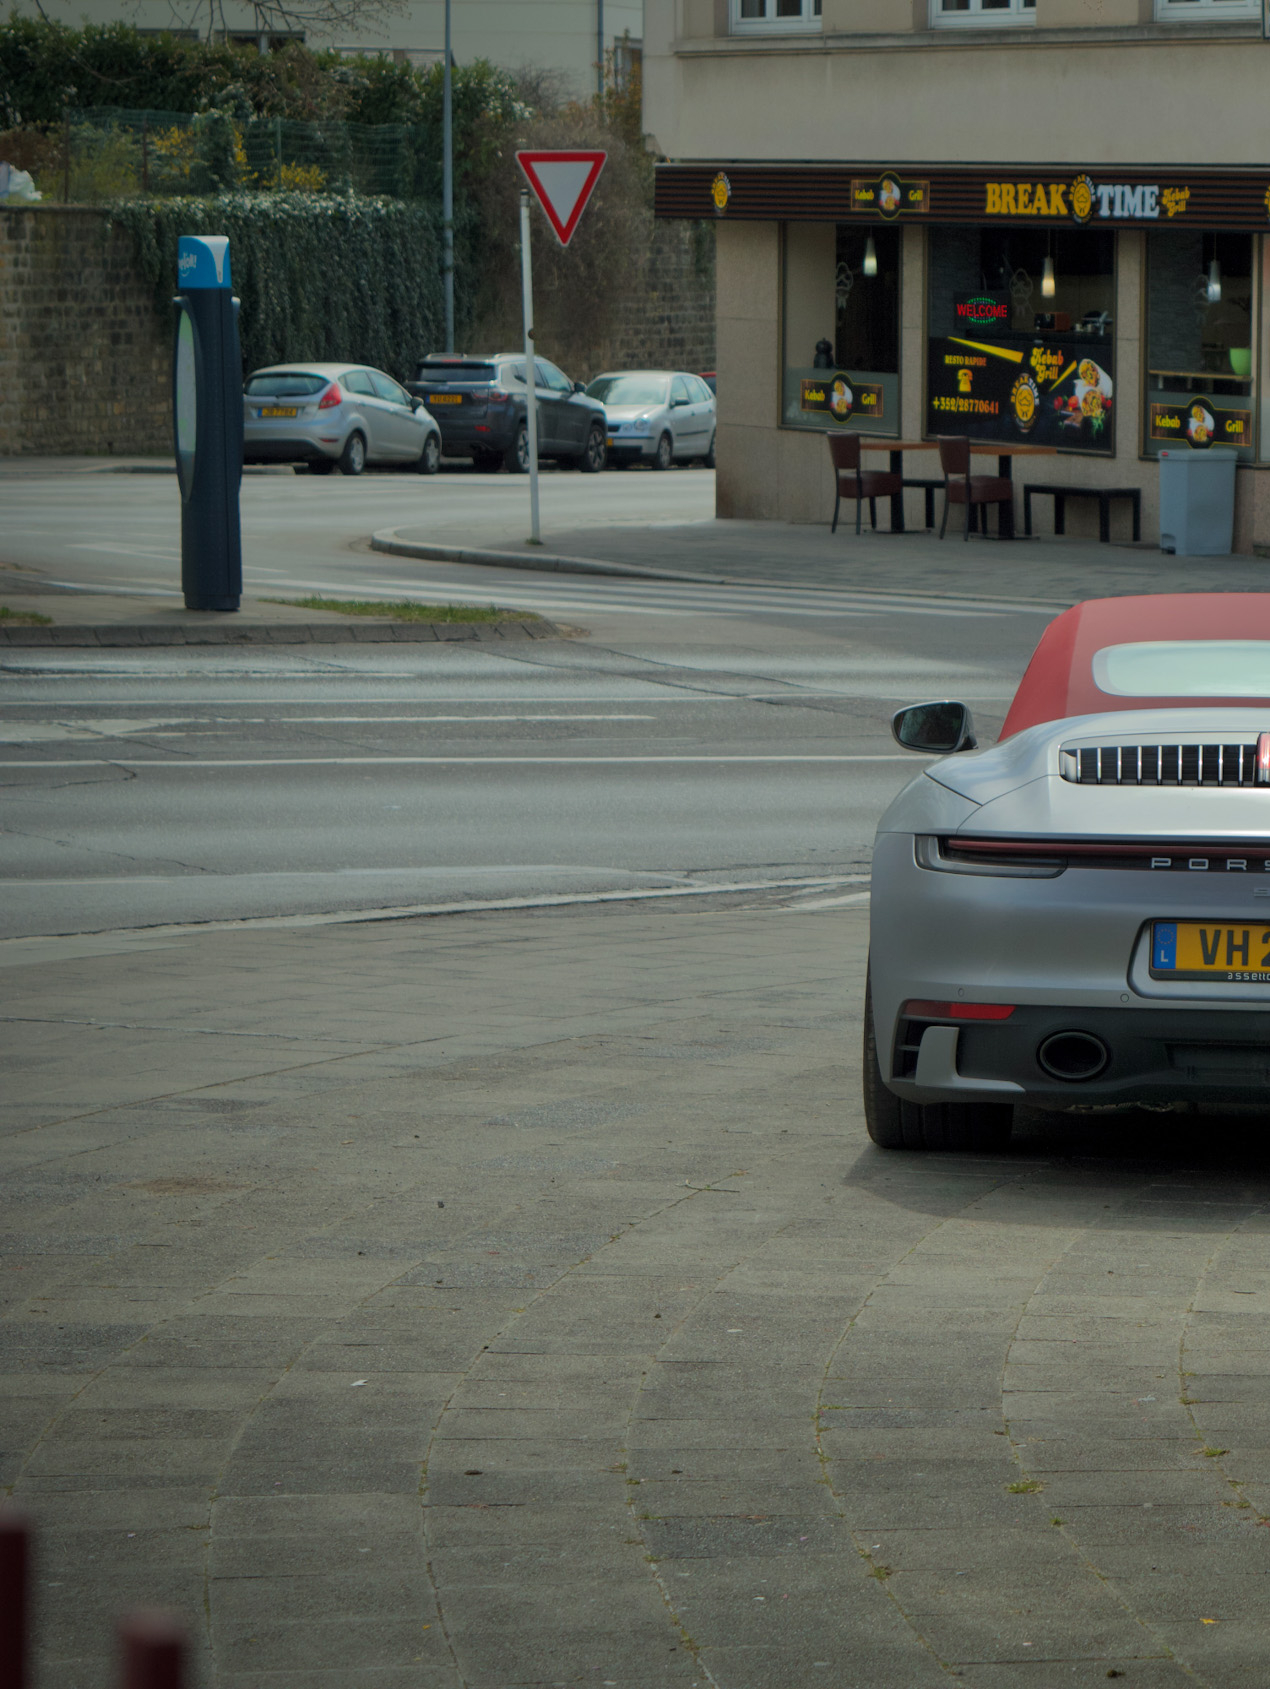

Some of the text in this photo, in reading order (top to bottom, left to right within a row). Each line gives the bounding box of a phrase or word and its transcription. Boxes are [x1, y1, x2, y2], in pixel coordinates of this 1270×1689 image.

[855, 188, 923, 201] Kebab Grill
[985, 183, 1160, 217] BREAK TIME
[1162, 186, 1190, 205] Kebab
[1167, 200, 1186, 217] Grill
[956, 303, 1008, 318] WELCOME
[944, 354, 987, 367] RESTO RAPIDE
[1030, 347, 1064, 367] Kebab
[1035, 364, 1059, 383] Grill
[804, 389, 877, 405] Kebab Grill
[932, 396, 999, 414] +352/28770641
[1155, 414, 1244, 433] Kebab Grill
[1160, 949, 1169, 963] L
[1199, 928, 1249, 967] VH
